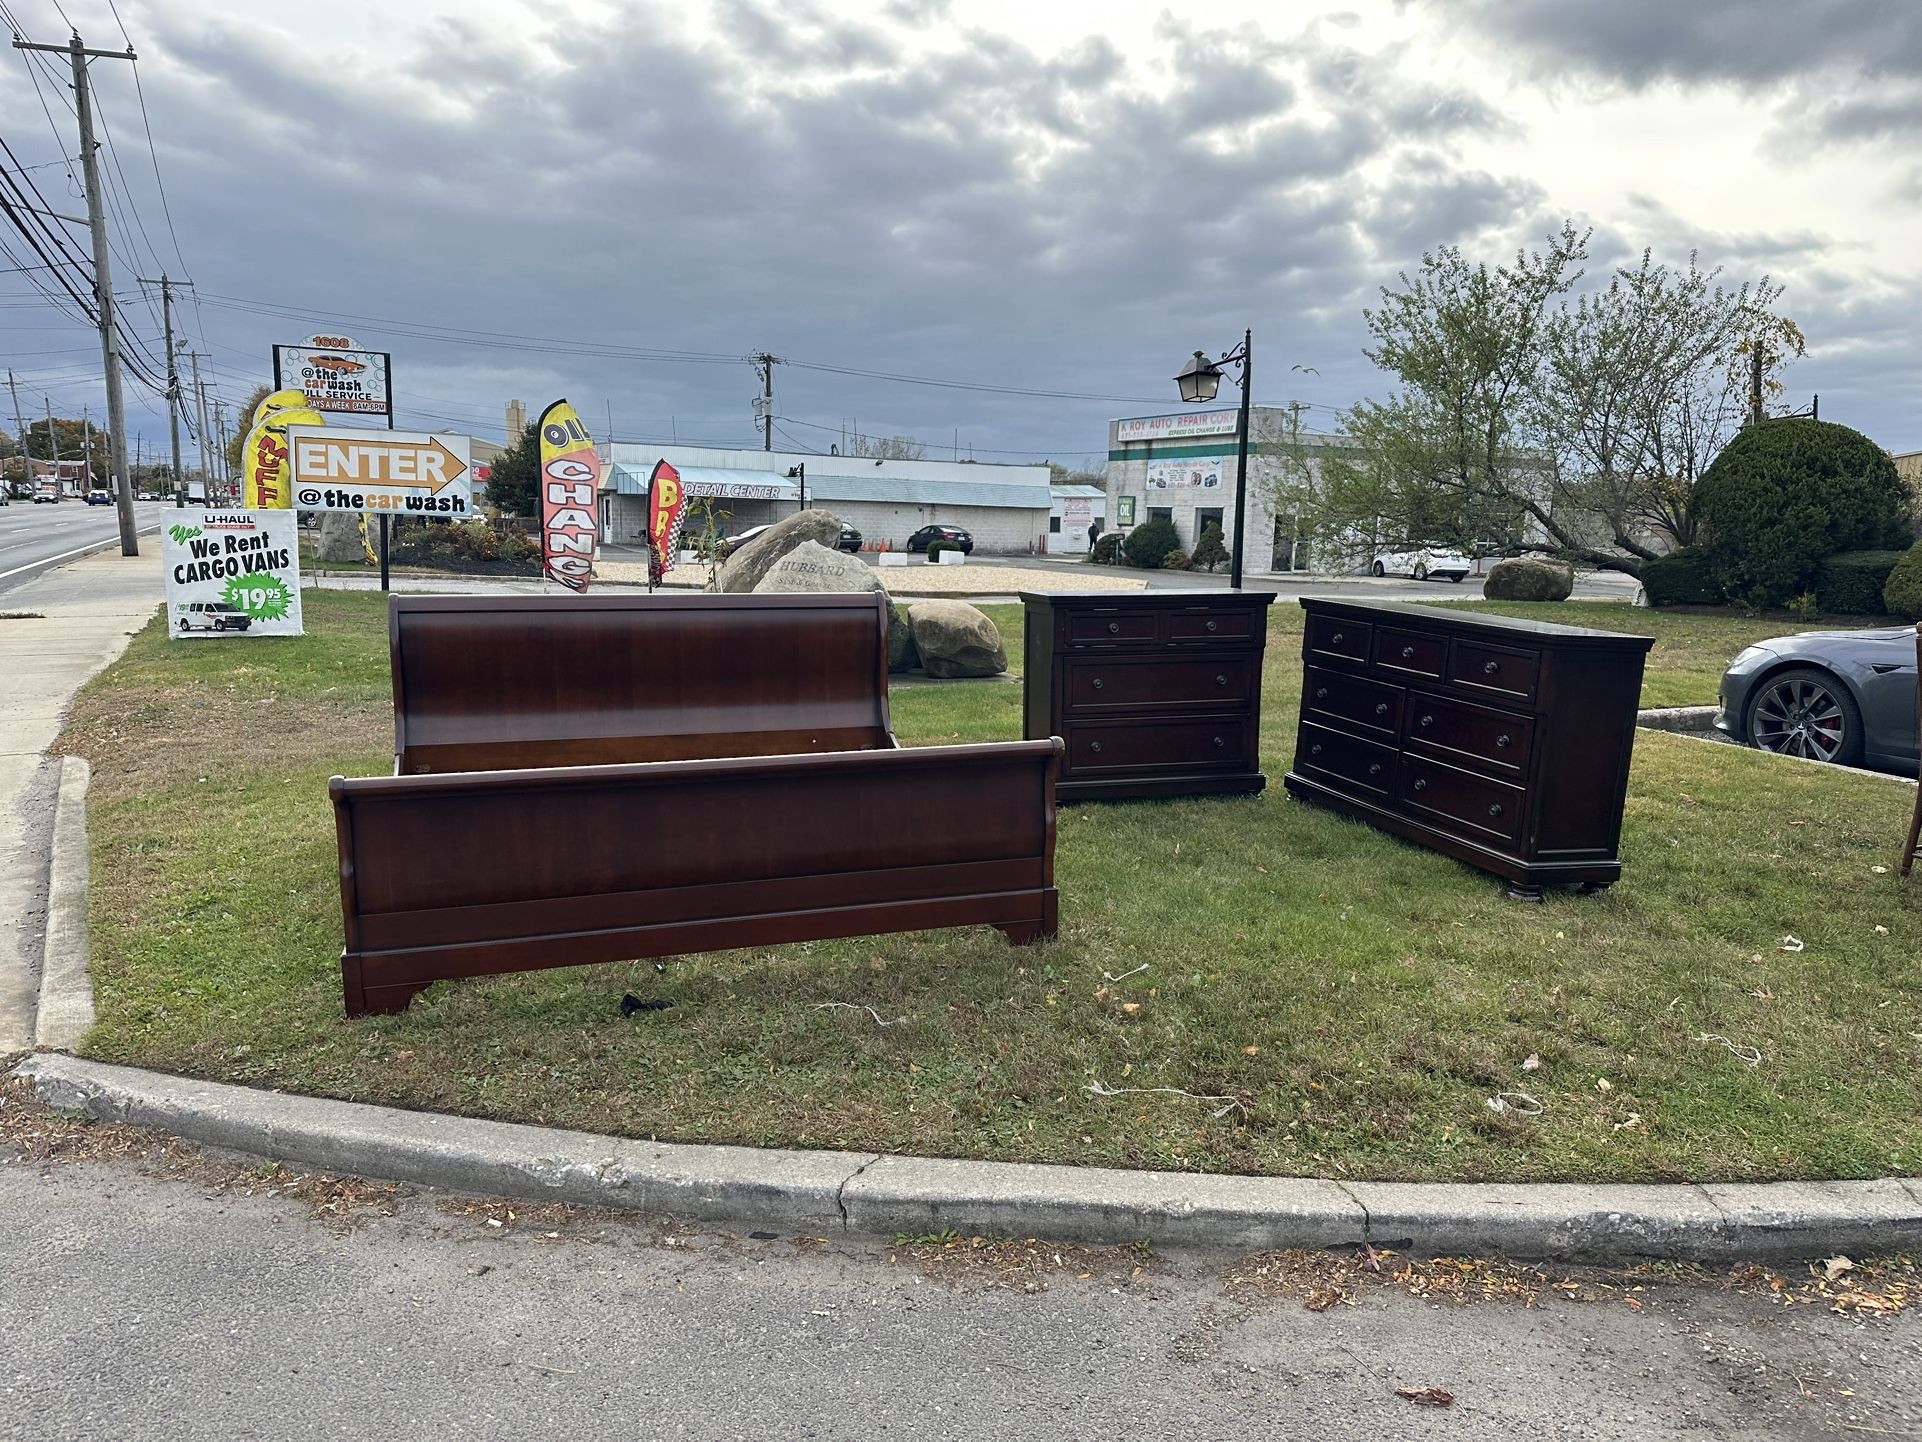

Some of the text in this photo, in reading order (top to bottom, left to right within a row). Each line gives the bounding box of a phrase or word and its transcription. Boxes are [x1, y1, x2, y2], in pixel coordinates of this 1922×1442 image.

[312, 336, 350, 348] 1608
[301, 389, 372, 400] ULL SERVICE
[326, 400, 330, 409] A
[331, 401, 350, 409] WEEK
[1130, 420, 1146, 431] ROY
[1150, 418, 1172, 429] AUTO
[1177, 414, 1208, 427] REPAIR
[1210, 411, 1236, 424] CORP
[543, 418, 592, 449] OIL
[255, 434, 289, 509] MUFF
[298, 442, 447, 483] ENTER
[684, 482, 729, 496] DETAIL
[731, 484, 780, 499] CENTER
[1120, 504, 1130, 516] OIL
[204, 515, 255, 524] U-HAUL
[169, 524, 203, 546] Yes
[189, 531, 269, 559] We Rent
[173, 548, 290, 585] CARGO VANS
[780, 561, 846, 577] HUBBARD
